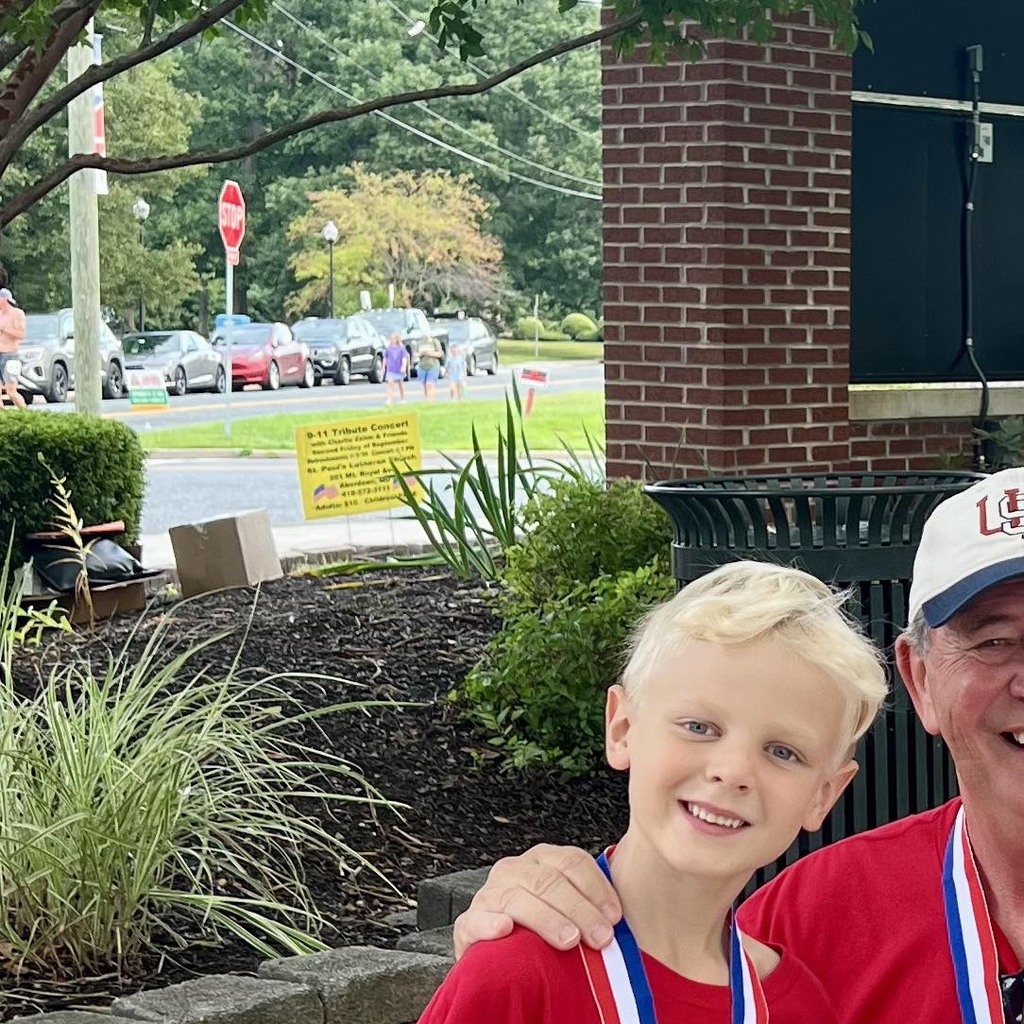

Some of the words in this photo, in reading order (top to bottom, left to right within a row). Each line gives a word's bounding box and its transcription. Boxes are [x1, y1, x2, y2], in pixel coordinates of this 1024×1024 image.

[222, 202, 243, 230] STOP
[331, 426, 368, 436] Tribute
[371, 420, 408, 431] Concert
[349, 459, 386, 468] Lutheran
[389, 453, 416, 463] hurch
[359, 468, 380, 477] Royal
